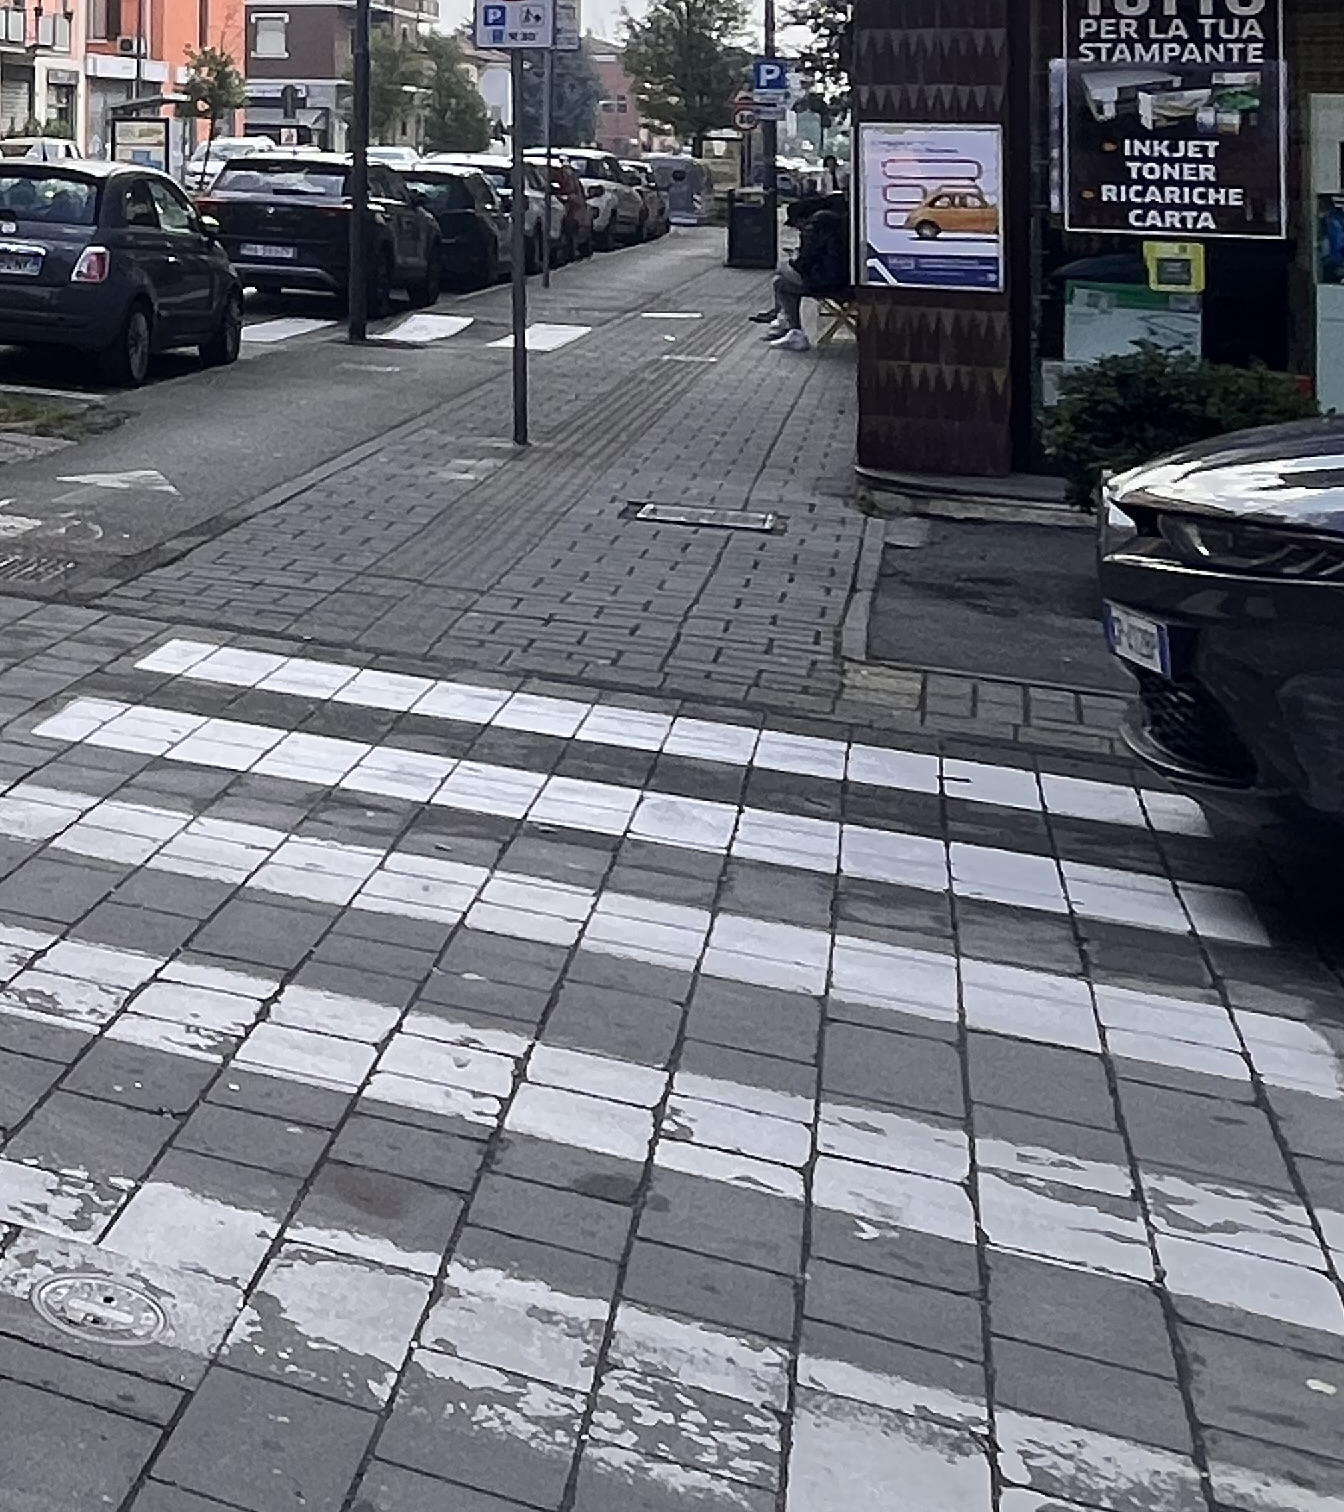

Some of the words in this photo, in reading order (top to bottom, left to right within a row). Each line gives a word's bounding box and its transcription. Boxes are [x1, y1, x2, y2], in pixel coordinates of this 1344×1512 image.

[1078, 18, 1140, 40] PER
[1148, 18, 1189, 40] LA
[1197, 18, 1266, 40] TUA
[1078, 42, 1265, 64] STAMPANTE
[1124, 138, 1220, 159] INKJET
[1124, 161, 1217, 182] TONER
[1100, 184, 1245, 207] RICARICHE
[1127, 208, 1217, 230] CARTA
